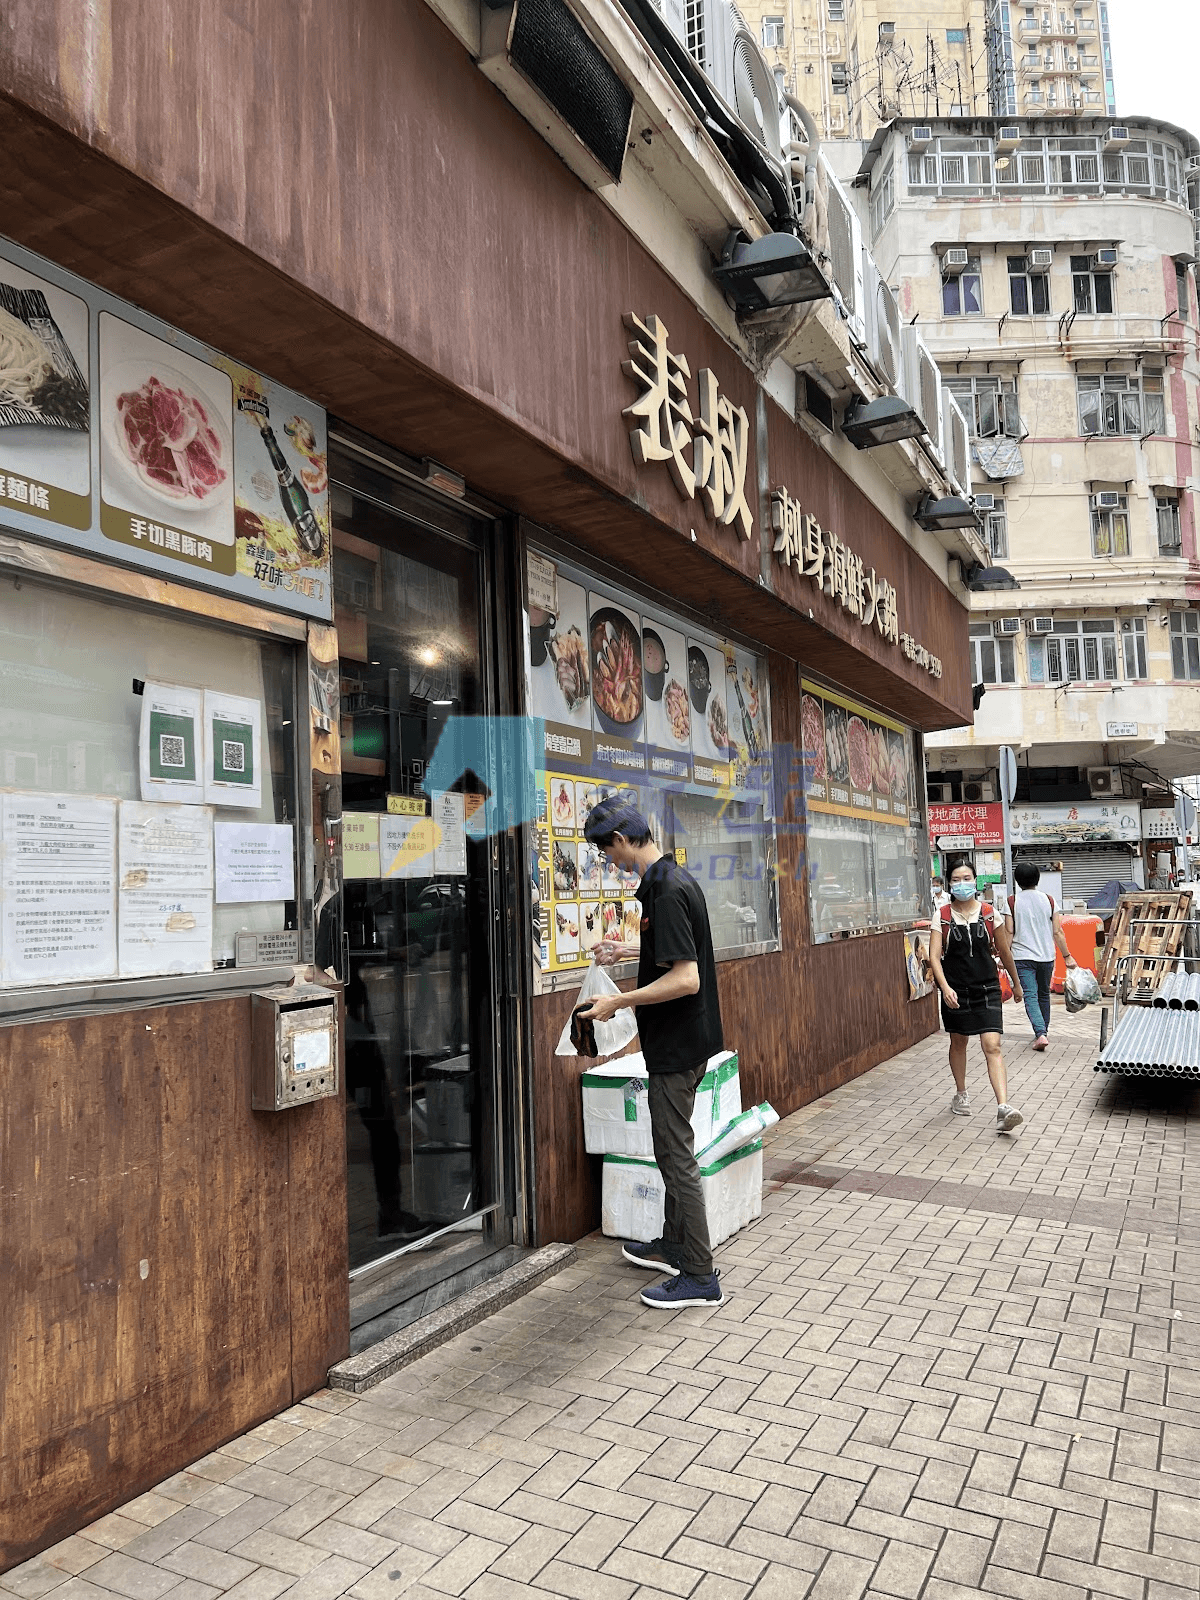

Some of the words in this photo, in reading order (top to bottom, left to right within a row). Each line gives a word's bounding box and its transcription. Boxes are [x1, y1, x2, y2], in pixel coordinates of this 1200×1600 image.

[130, 517, 213, 562] 手切黑豚肉
[770, 485, 899, 646] 刺身海鮮火鍋
[1067, 807, 1079, 821] 唐
